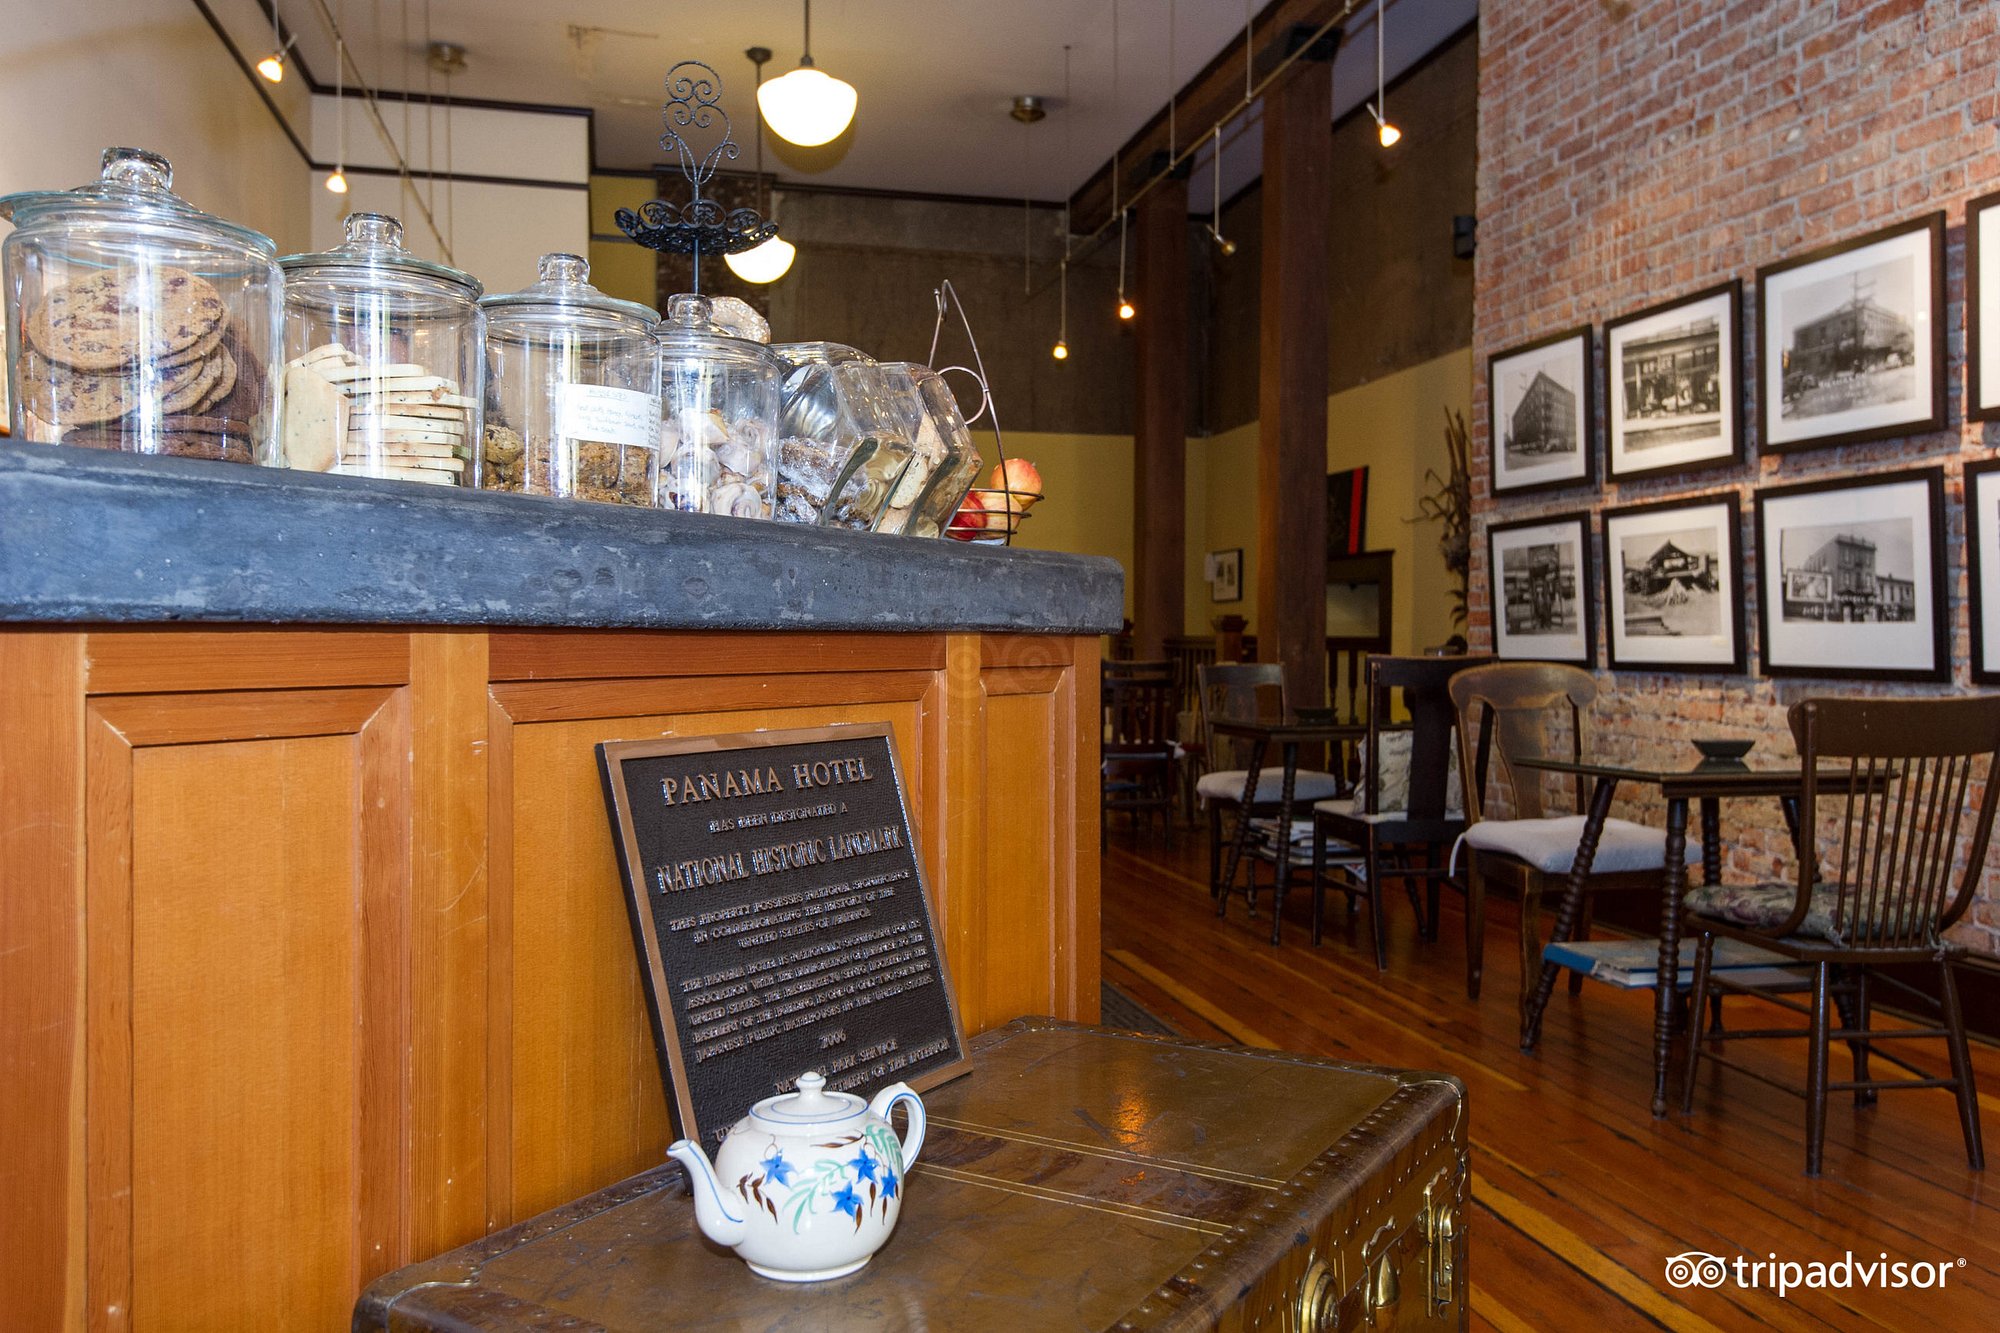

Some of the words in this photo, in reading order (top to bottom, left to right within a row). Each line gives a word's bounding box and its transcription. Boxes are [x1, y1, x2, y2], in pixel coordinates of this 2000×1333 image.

[660, 767, 784, 806] PANAMA
[792, 757, 873, 789] HOTEL
[710, 819, 735, 833] HAS
[738, 812, 768, 829] BEEN
[771, 803, 836, 824] DESIGNATED
[840, 802, 848, 813] A
[657, 852, 750, 894] NATIONAL
[752, 839, 827, 876] HISTORIC
[829, 826, 904, 861] LANDMARK
[699, 904, 751, 926] PROPERTY
[753, 893, 803, 913] POSSESSES
[820, 1029, 846, 1049] 2006
[831, 1053, 857, 1073] PARK
[858, 1039, 898, 1061] SERVICE
[872, 1064, 886, 1077] OF
[888, 1056, 908, 1072] THE
[909, 1037, 950, 1063] INTERIOR
